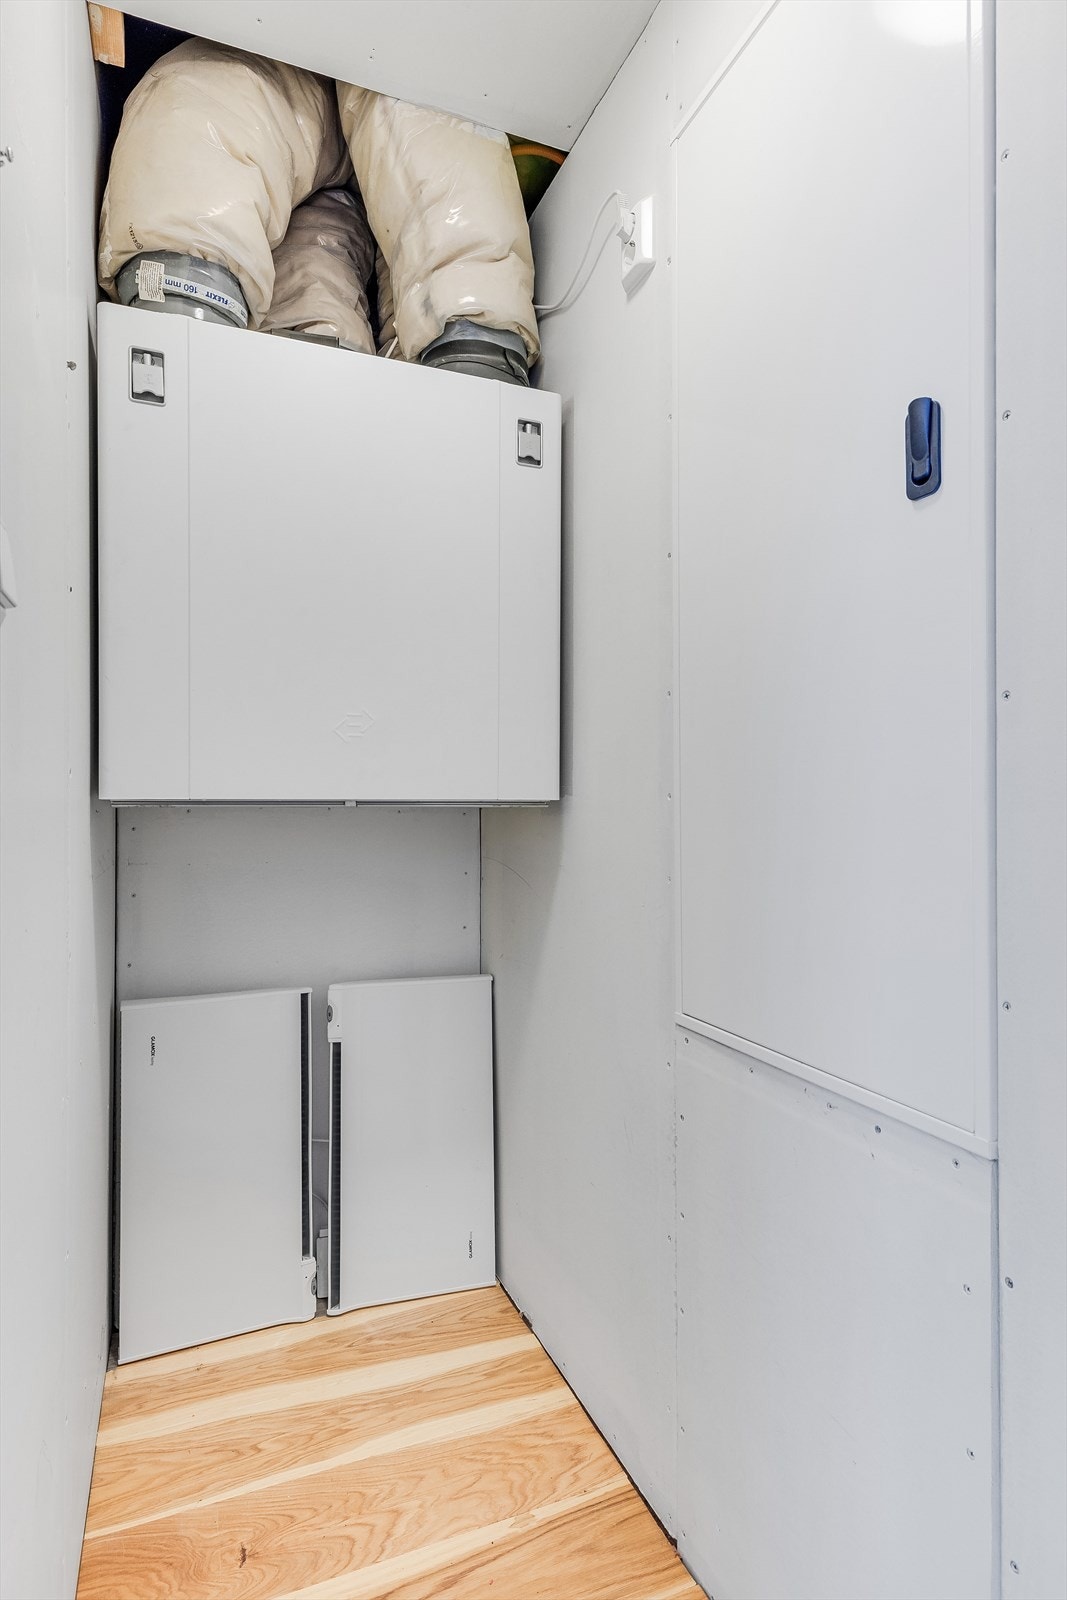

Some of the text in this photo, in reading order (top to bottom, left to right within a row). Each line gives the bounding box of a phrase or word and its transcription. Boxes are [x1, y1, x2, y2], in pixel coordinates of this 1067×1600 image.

[164, 278, 228, 305] FLEXIT 160 mm
